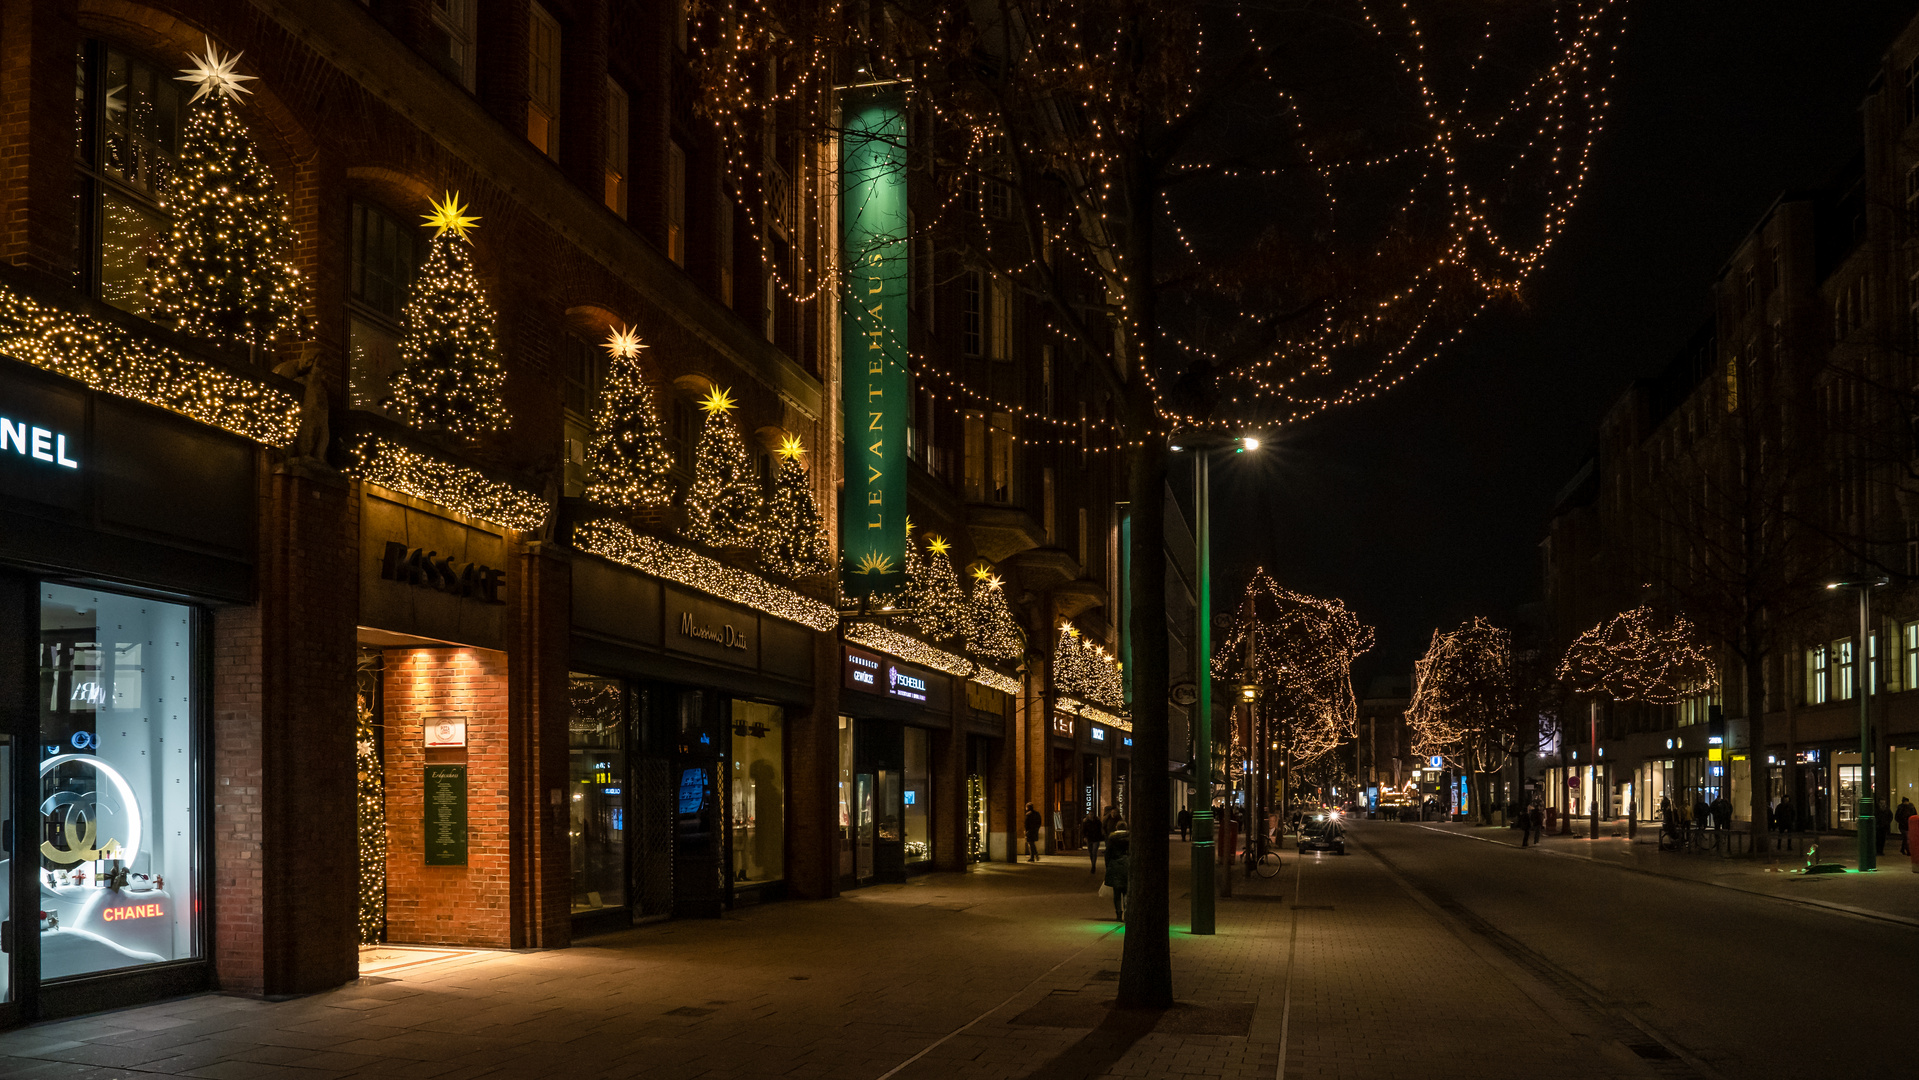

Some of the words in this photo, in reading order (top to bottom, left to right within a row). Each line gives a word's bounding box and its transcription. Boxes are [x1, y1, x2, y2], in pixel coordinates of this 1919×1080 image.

[868, 252, 884, 531] LEVANTEHAUS
[0, 416, 78, 469] NEL
[680, 611, 724, 645] Massimo
[724, 623, 747, 651] Dutti
[896, 673, 927, 692] TSCHEBULL
[1431, 756, 1441, 767] U
[102, 903, 165, 923] CHANEL
